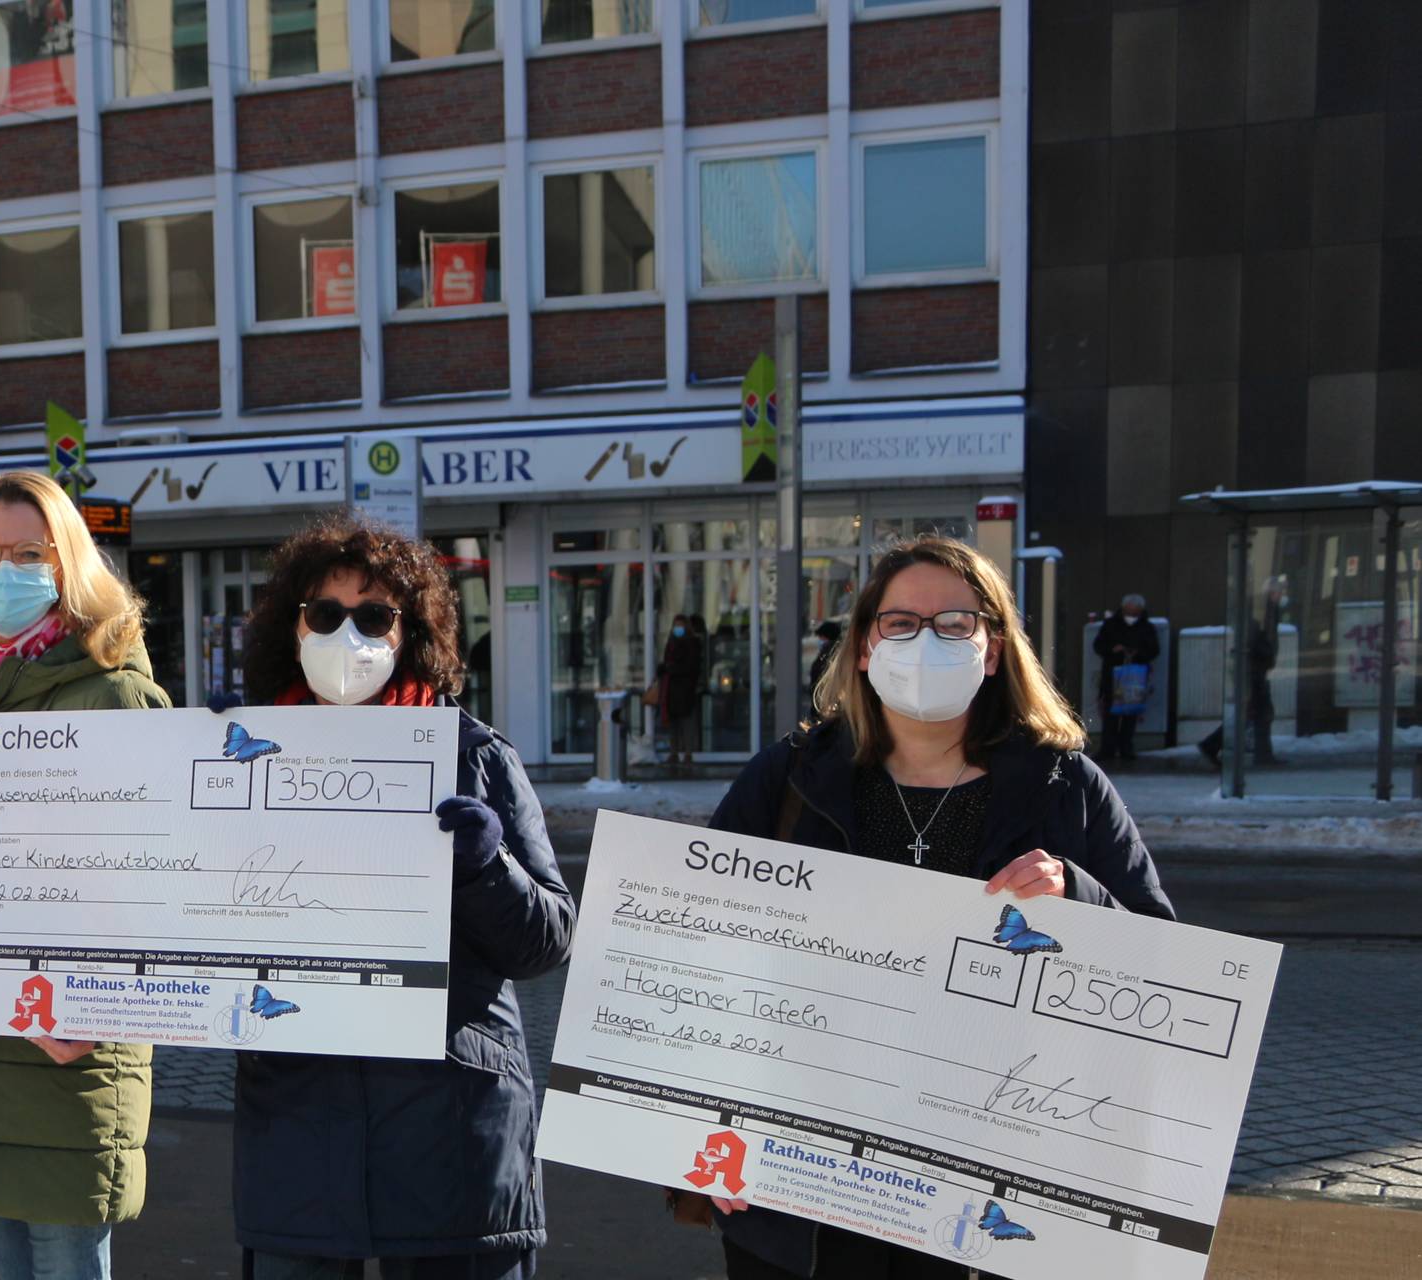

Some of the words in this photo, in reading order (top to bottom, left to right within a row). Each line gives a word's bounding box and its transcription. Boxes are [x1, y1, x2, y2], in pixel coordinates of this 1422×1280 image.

[808, 431, 1013, 462] PRESSEWELT
[413, 729, 434, 742] DE
[13, 768, 42, 777] diesen
[45, 768, 77, 777] Scheck
[275, 756, 302, 764] Betrag:
[305, 756, 326, 764] Euro,
[207, 777, 233, 788] EUR
[26, 847, 202, 871] Kinderschutzbund
[684, 837, 815, 893] Scheck
[182, 907, 227, 917] Unterschrift
[230, 909, 243, 917] des
[246, 909, 289, 918] Ausstellers
[618, 877, 657, 896] Zahlen
[661, 885, 680, 899] Sie
[683, 890, 719, 909] gegen
[722, 897, 761, 915] diesen
[765, 905, 808, 924] Scheck
[611, 916, 640, 932] Betrag
[643, 923, 651, 932] in
[653, 923, 706, 944] Buchstaben
[604, 951, 626, 964] noch
[628, 957, 657, 972] Betrag
[659, 963, 668, 973] in
[670, 964, 723, 985] Buchstaben
[968, 960, 1001, 978] EUR
[1053, 957, 1085, 972] Betrag:
[1088, 965, 1113, 978] Euro,
[1116, 971, 1139, 983] Cent
[1222, 960, 1249, 979] DE
[65, 975, 210, 997] Rathaus-Apotheke
[600, 977, 614, 988] an
[65, 994, 120, 1004] Internationale
[122, 996, 160, 1007] Apotheke
[163, 998, 174, 1006] Dr.
[90, 1006, 156, 1016] Gesundheitszentrum
[158, 1009, 191, 1018] Badstraße
[621, 967, 737, 1028] Hagener
[739, 986, 830, 1033] Tafeln
[663, 1037, 693, 1053] Datum
[917, 1096, 969, 1119] Unterschrift
[971, 1111, 987, 1123] des
[989, 1115, 1041, 1137] Ausstellers
[596, 1074, 610, 1085] Der
[611, 1077, 659, 1097] vorgedruckte
[661, 1087, 701, 1105] Schecktext
[703, 1097, 718, 1107] darf
[720, 1101, 737, 1111] nicht
[739, 1104, 773, 1120] geändert
[774, 1112, 791, 1123] oder
[793, 1117, 831, 1134] gestrichen
[833, 1127, 863, 1140] werden.
[865, 1135, 877, 1144] Die
[878, 1138, 908, 1154] Angabe
[910, 1148, 928, 1158] einer
[929, 1152, 978, 1174] Zahlungsfrist
[979, 1166, 993, 1176] auf
[994, 1170, 1011, 1181] dem
[1012, 1176, 1042, 1191] Scheck
[1043, 1184, 1055, 1195] gilt
[1056, 1188, 1068, 1198] als
[1070, 1192, 1090, 1204] nicht
[1091, 1198, 1145, 1220] geschrieben.
[760, 1157, 828, 1182] Internationale
[829, 1175, 876, 1196] Apotheke
[878, 1188, 893, 1199] Dr.
[762, 1137, 938, 1198] Rathaus-Apotheke
[777, 1174, 787, 1183] Im
[789, 1177, 870, 1206] Gesundheitszentrum
[871, 1199, 910, 1217] Badstraße
[752, 1193, 790, 1210] Kompetent,
[791, 1203, 824, 1219] engagiert,
[826, 1212, 874, 1232] gastfreundlich
[882, 1228, 925, 1246] ganzheitlich!
